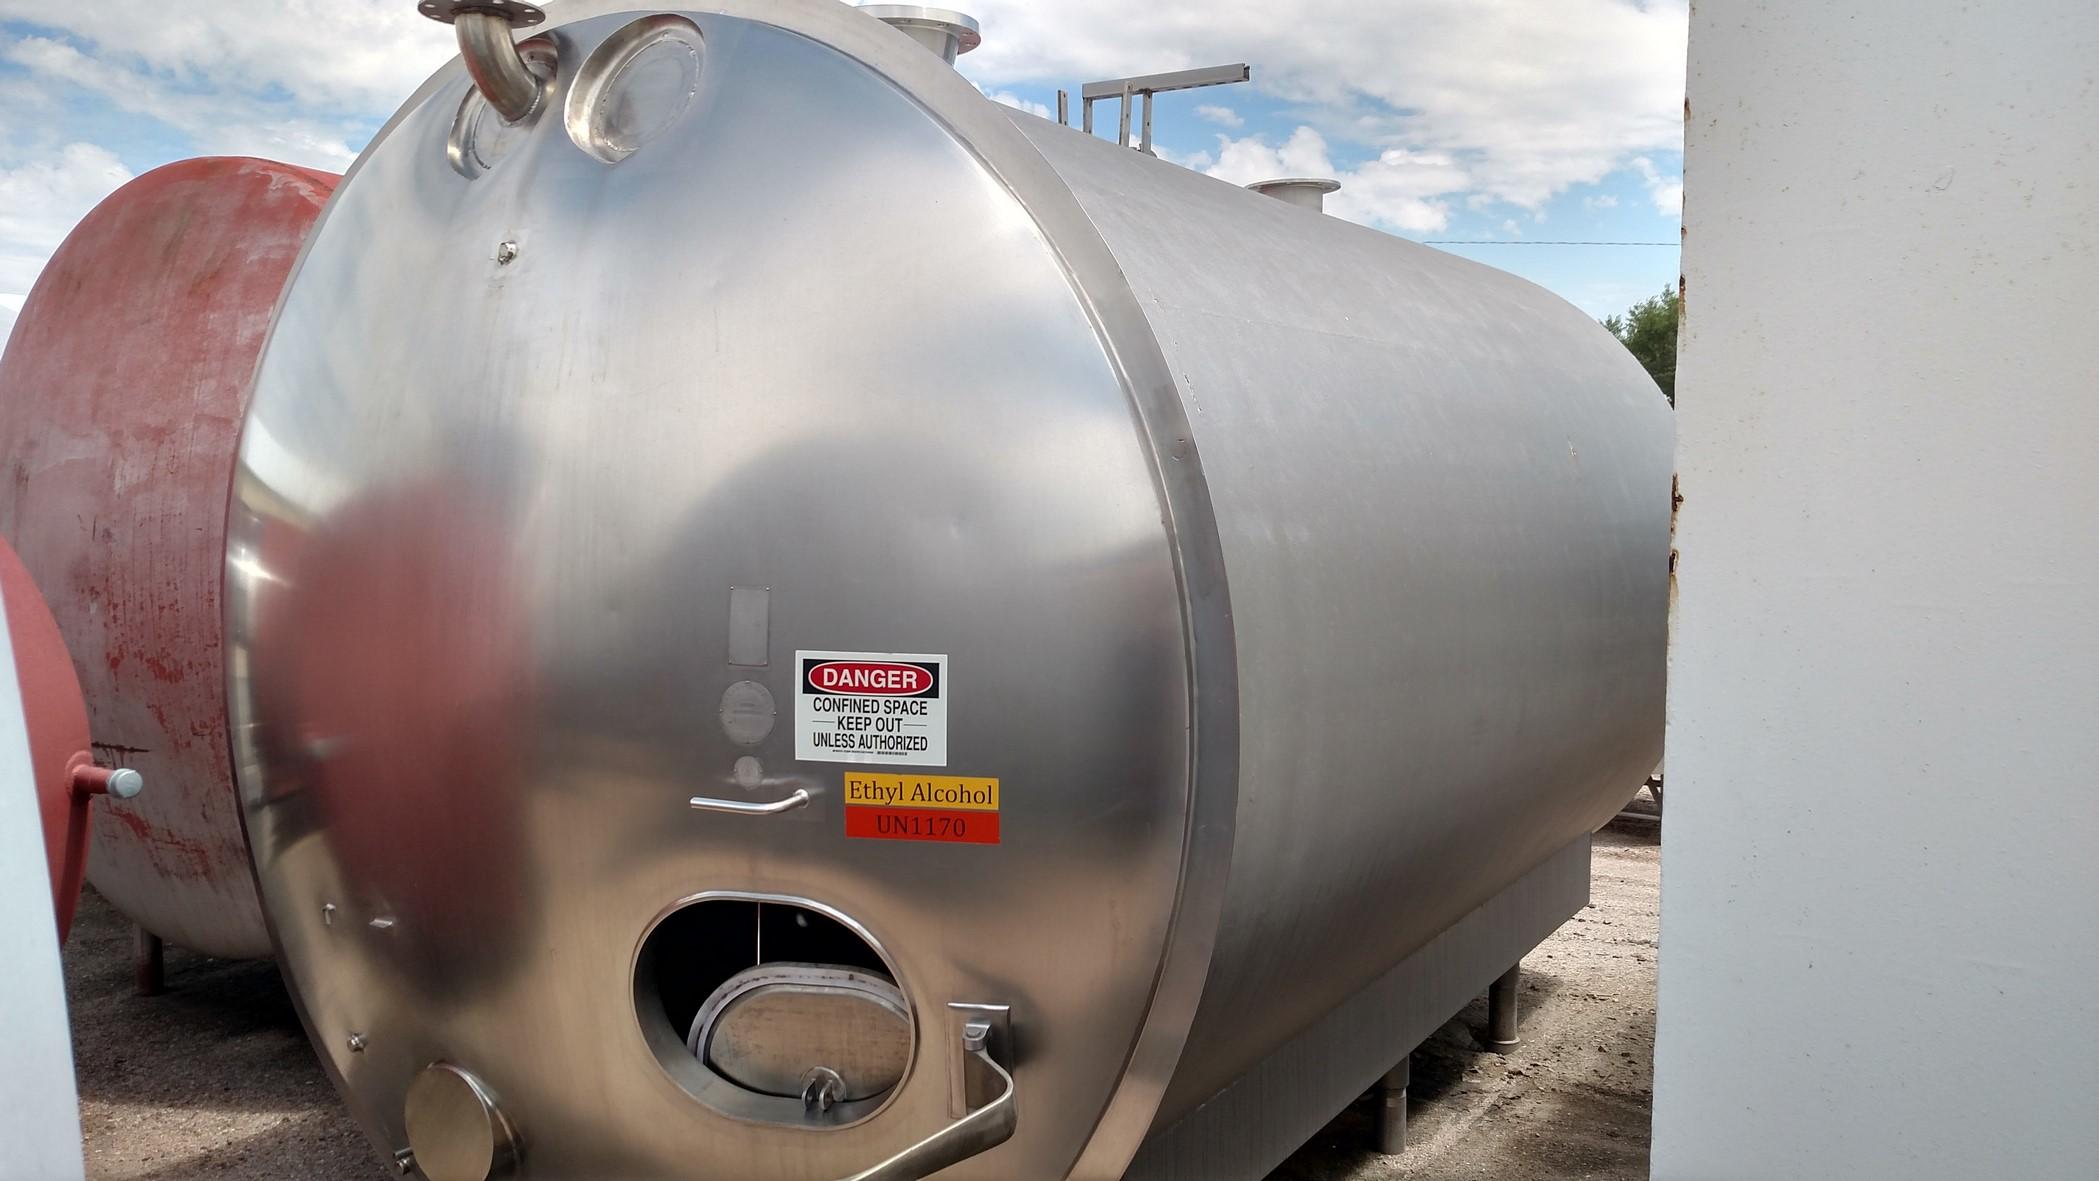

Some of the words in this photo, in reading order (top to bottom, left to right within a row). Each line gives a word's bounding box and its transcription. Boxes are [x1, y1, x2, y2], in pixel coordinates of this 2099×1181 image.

[823, 668, 917, 689] DANGER
[813, 697, 880, 714] CONFINED
[884, 700, 928, 715] SPACE
[837, 716, 872, 731] KEEP
[876, 718, 903, 732] OUT
[813, 733, 855, 748] UNLESS
[859, 735, 928, 751] AUTHORIZED
[849, 781, 904, 805] Ethyl
[911, 783, 993, 804] Alcohol
[877, 815, 966, 837] UN1170
